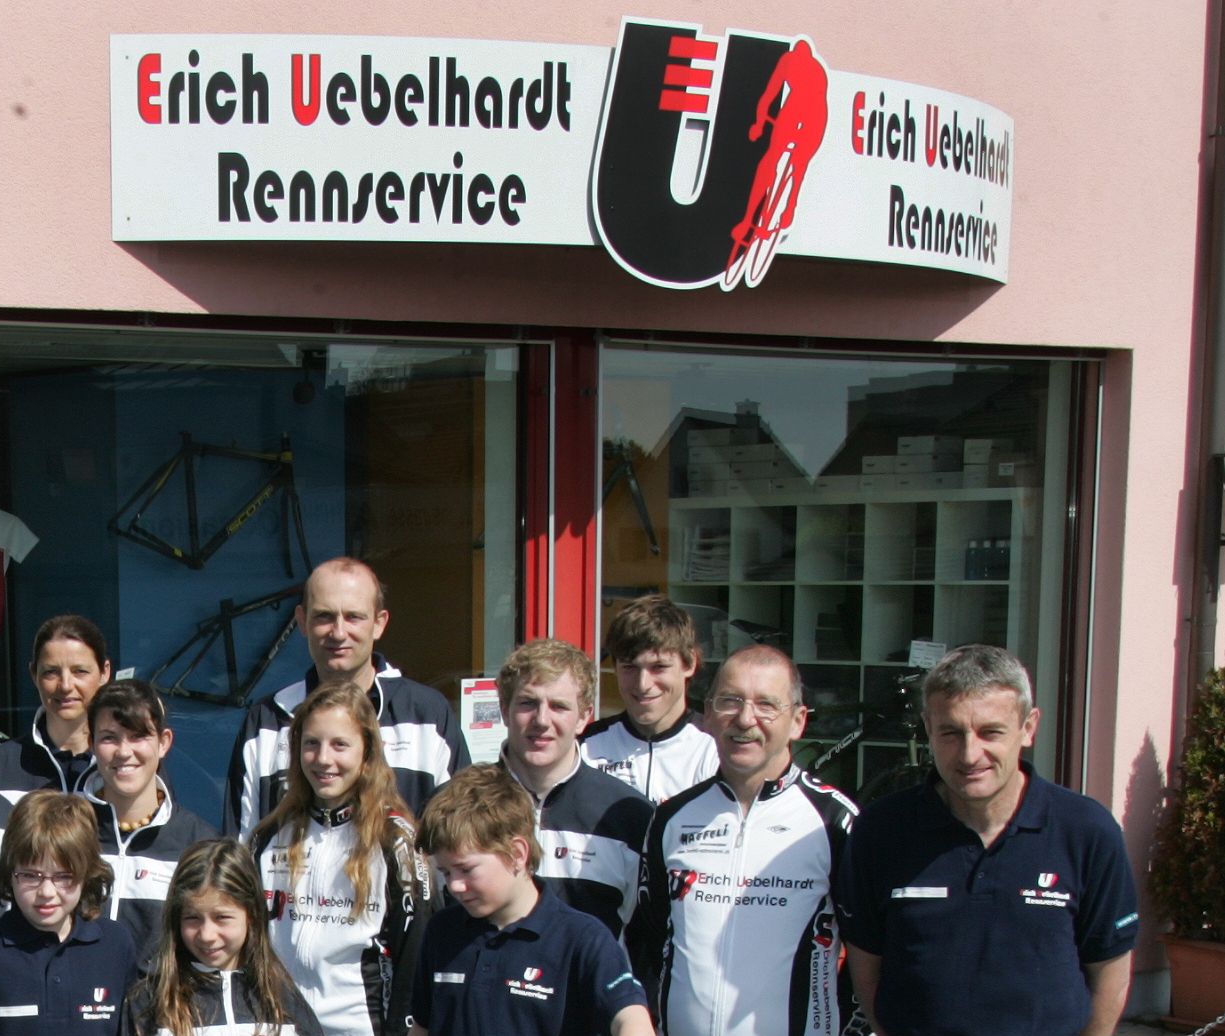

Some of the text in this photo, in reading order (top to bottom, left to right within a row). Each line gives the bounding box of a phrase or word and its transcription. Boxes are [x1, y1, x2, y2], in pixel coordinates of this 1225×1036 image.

[137, 52, 572, 131] Erich Uebelhardt
[851, 90, 1011, 191] Erich Uebelhardt
[217, 152, 527, 227] Rennservice
[888, 184, 998, 266] Rennservice
[698, 872, 815, 891] Erich Uebelhardt
